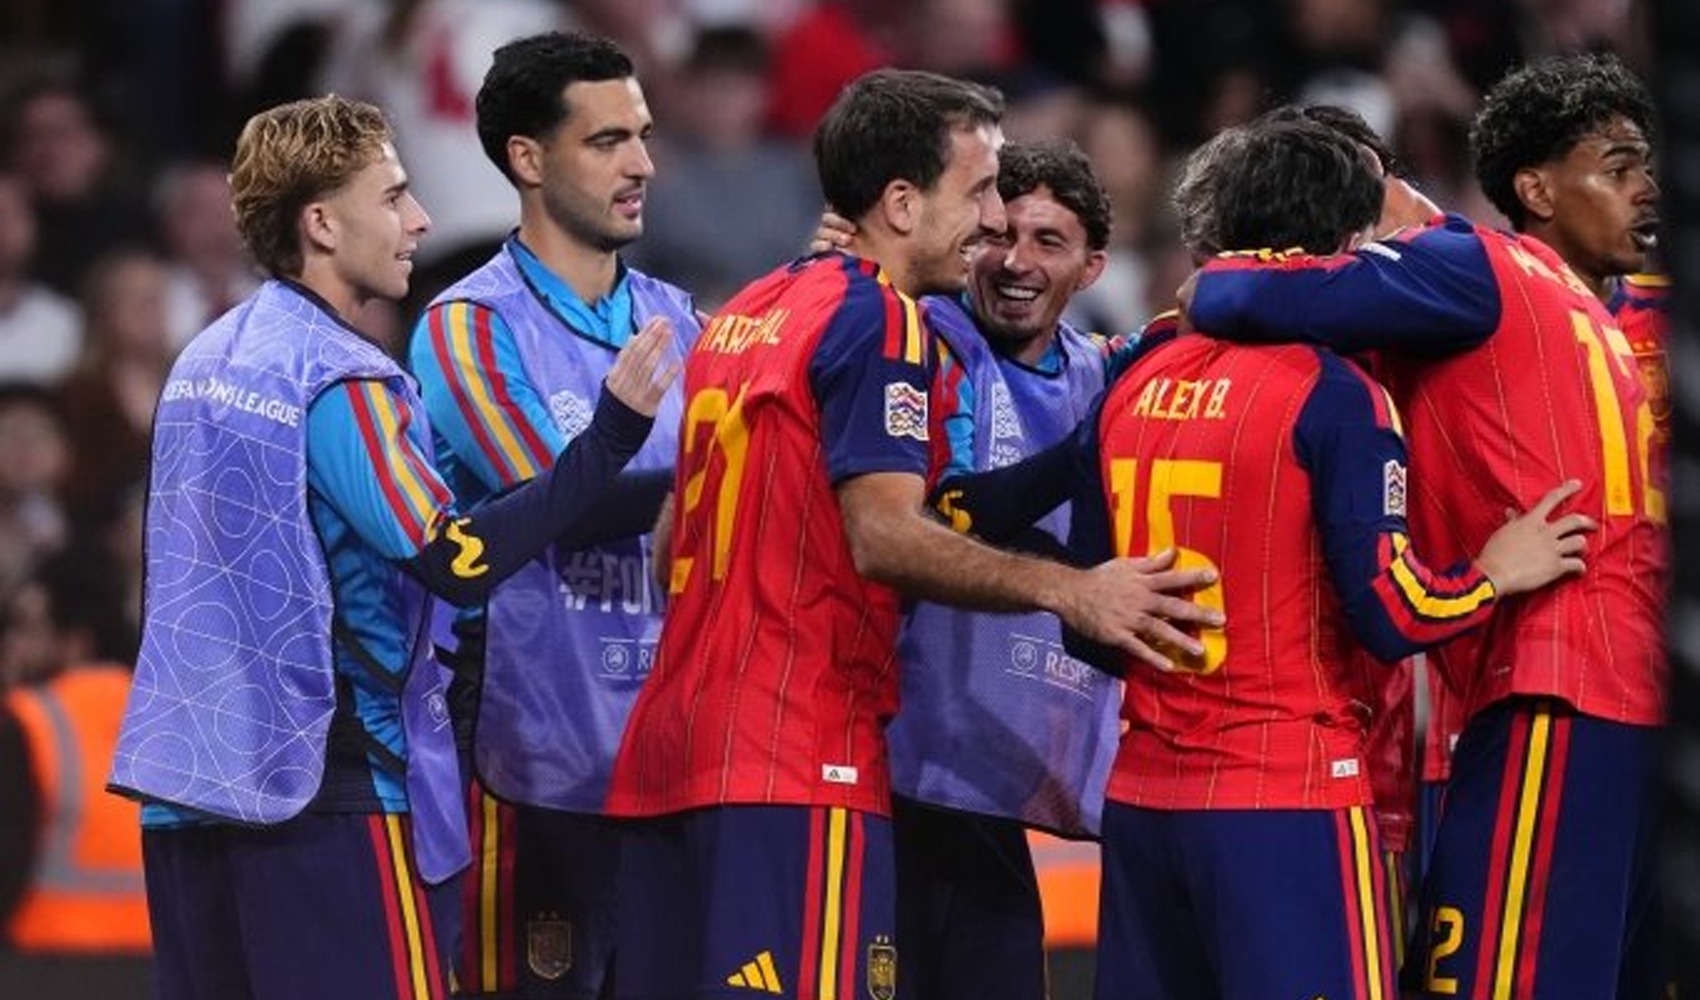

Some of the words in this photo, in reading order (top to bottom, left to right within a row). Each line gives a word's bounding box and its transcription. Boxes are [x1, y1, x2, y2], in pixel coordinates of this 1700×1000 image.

[234, 386, 300, 429] LEAGUE
[1133, 378, 1212, 420] ALEX
[670, 378, 750, 594] 21
[1110, 456, 1228, 675] 15
